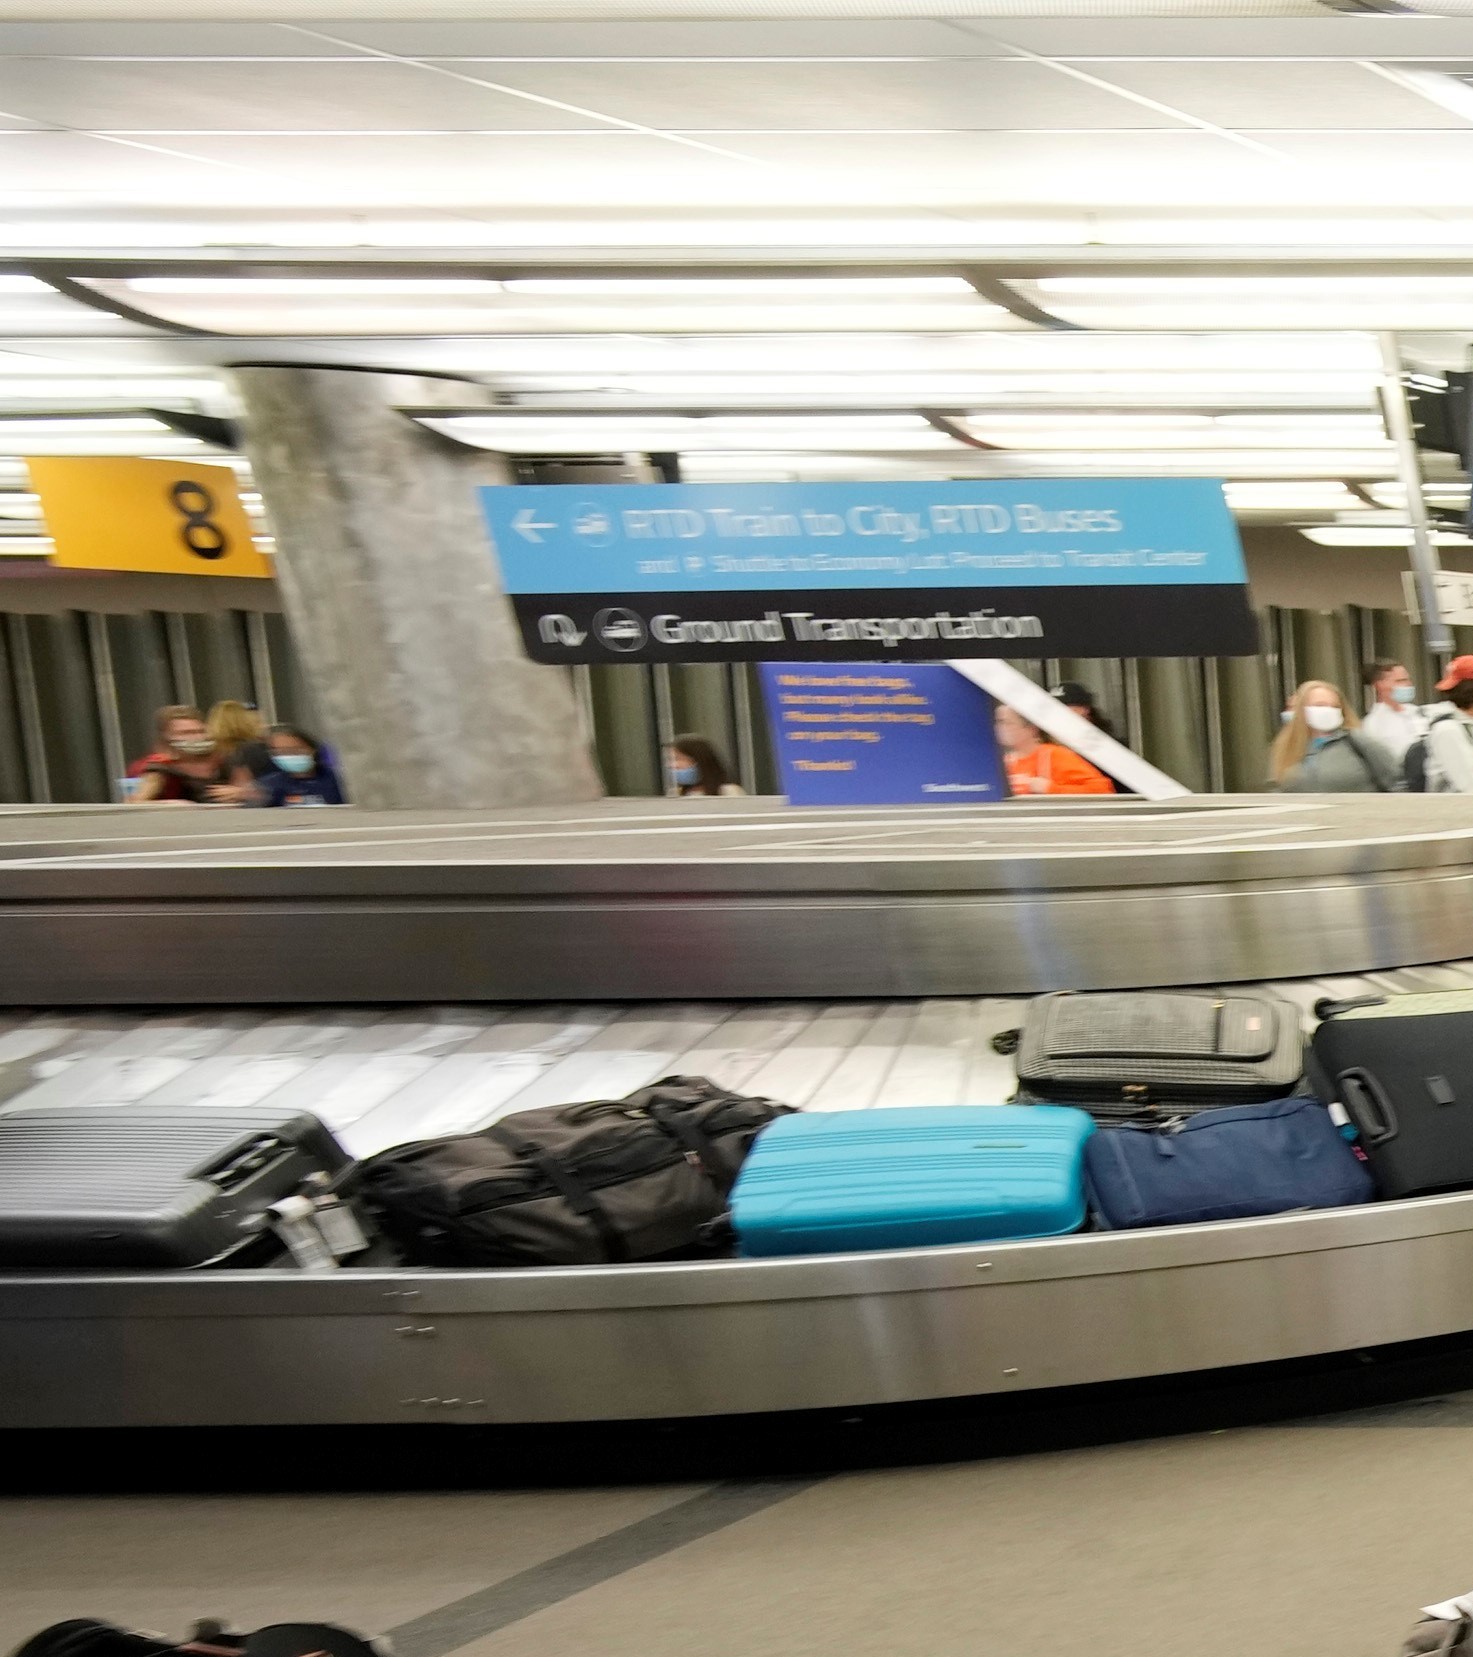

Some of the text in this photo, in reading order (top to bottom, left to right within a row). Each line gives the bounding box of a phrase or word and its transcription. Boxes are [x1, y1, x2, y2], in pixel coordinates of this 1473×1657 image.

[169, 479, 228, 561] 8
[621, 508, 706, 540] RTD
[703, 505, 802, 538] Train
[801, 508, 846, 537] to
[929, 503, 1013, 535] RTD
[1013, 502, 1124, 534] Buses
[649, 607, 1045, 648] Ground Transportation
